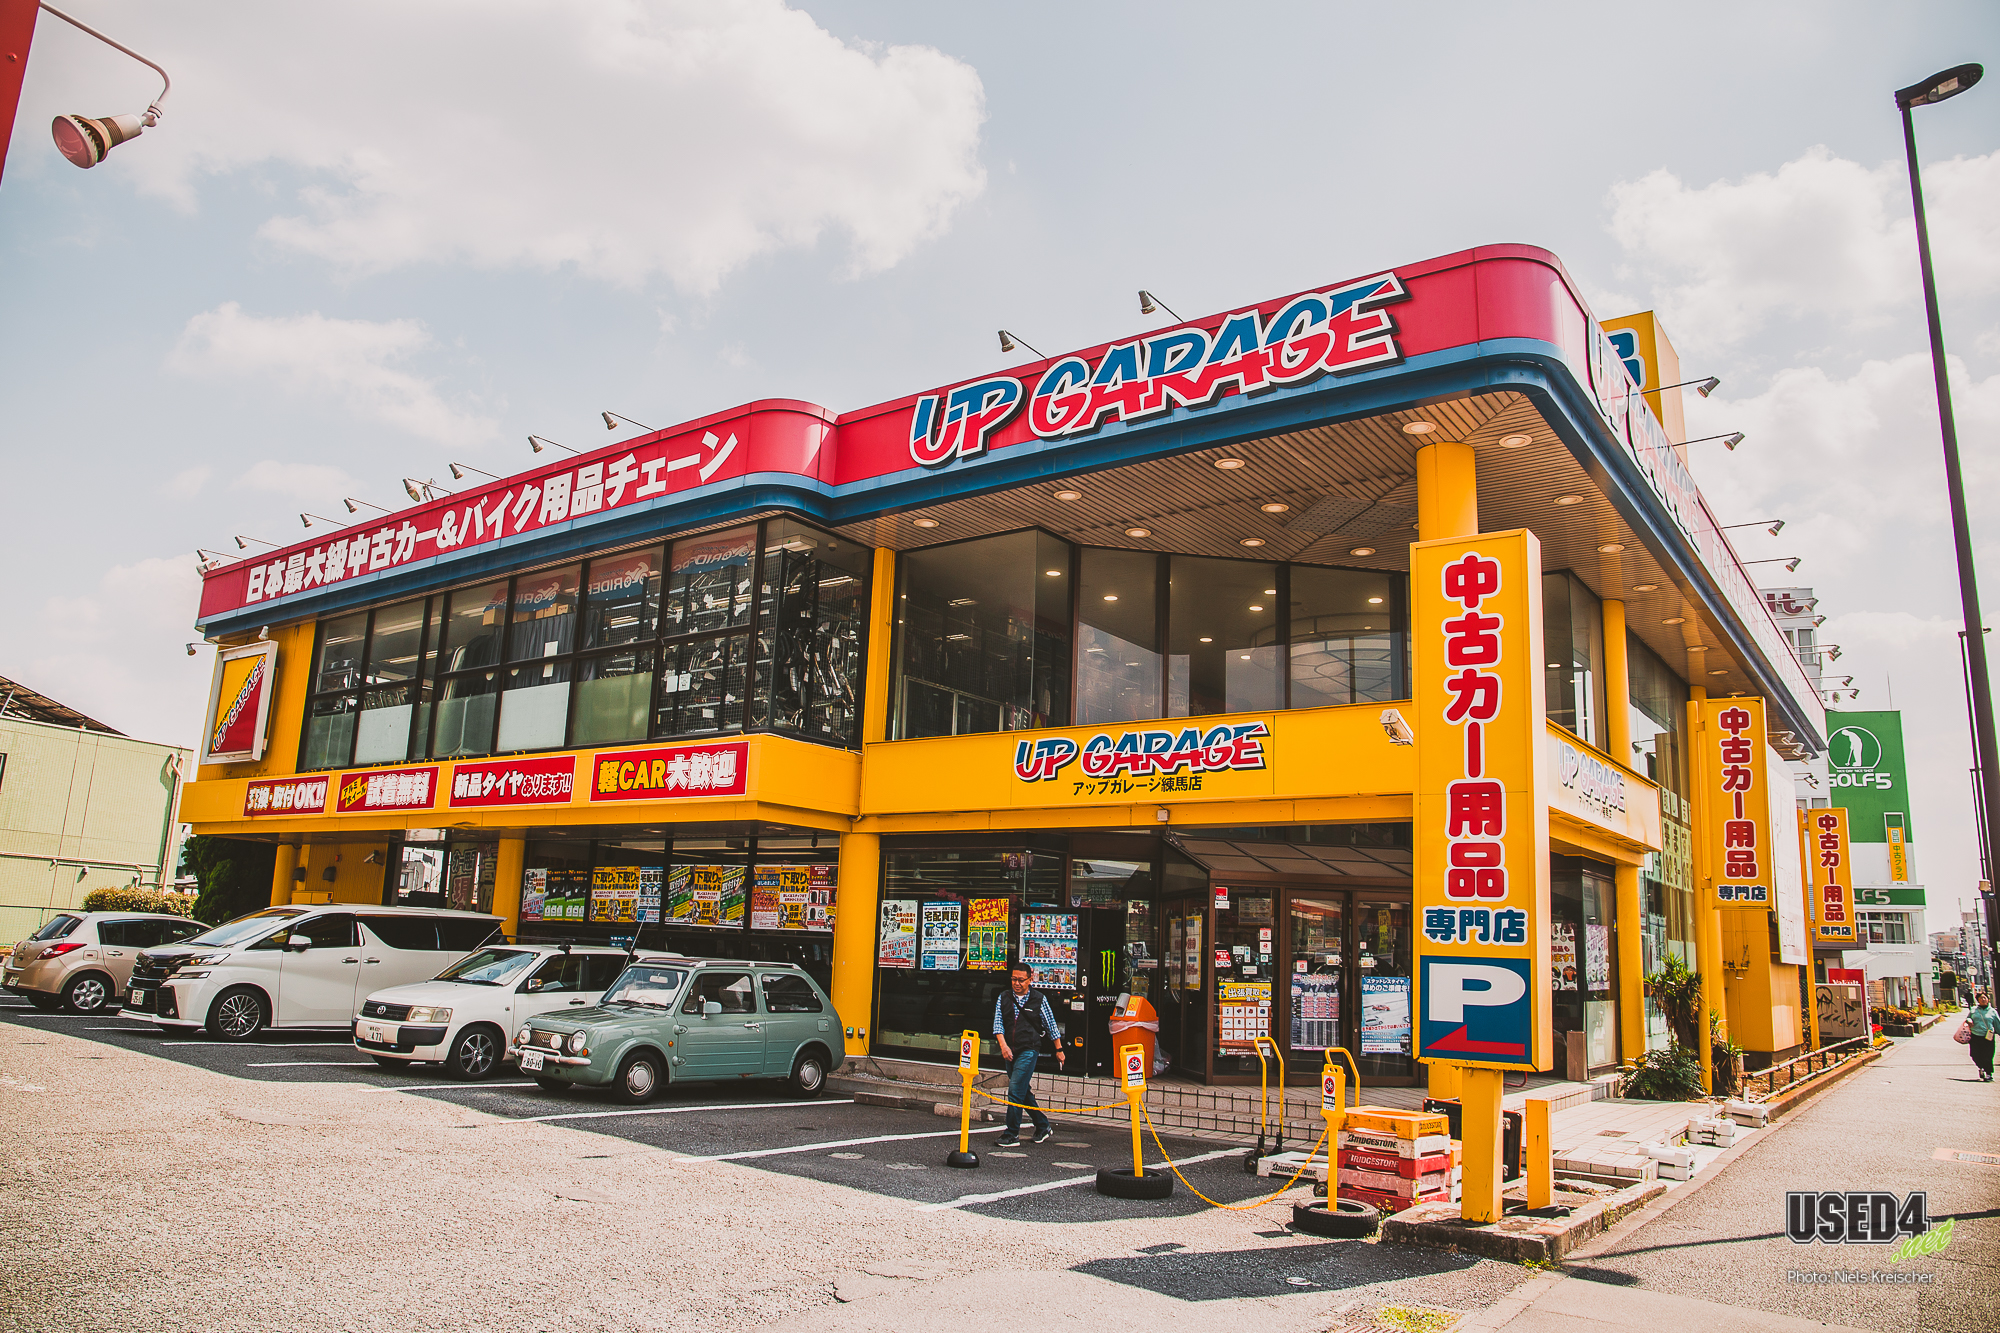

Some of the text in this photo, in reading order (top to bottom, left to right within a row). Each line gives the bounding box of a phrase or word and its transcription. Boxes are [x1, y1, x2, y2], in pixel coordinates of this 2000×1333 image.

[909, 271, 1405, 466] UP GARAGE
[245, 430, 738, 604] 日本最大級中古カー&バイク用品チェーン
[1441, 550, 1508, 902] 中古カー用品
[1014, 721, 1271, 781] UP GARAGE
[365, 771, 431, 807] 試着無料
[1073, 775, 1202, 796] アップガレージ練馬店
[1558, 738, 1626, 814] UP GARAGE
[1717, 705, 1758, 879] 中古カー用品
[1817, 813, 1846, 922] 中古カー用品
[1892, 845, 1904, 880] 中古クラブ
[1717, 884, 1768, 902] 専門店
[924, 911, 959, 921] 宅配買取
[1421, 906, 1529, 946] 専門店
[1819, 925, 1852, 936] 専門店
[1428, 962, 1526, 1023] P
[1347, 1133, 1398, 1149] BRIDGESTONE
[1271, 1163, 1318, 1177] BRIDGEONE
